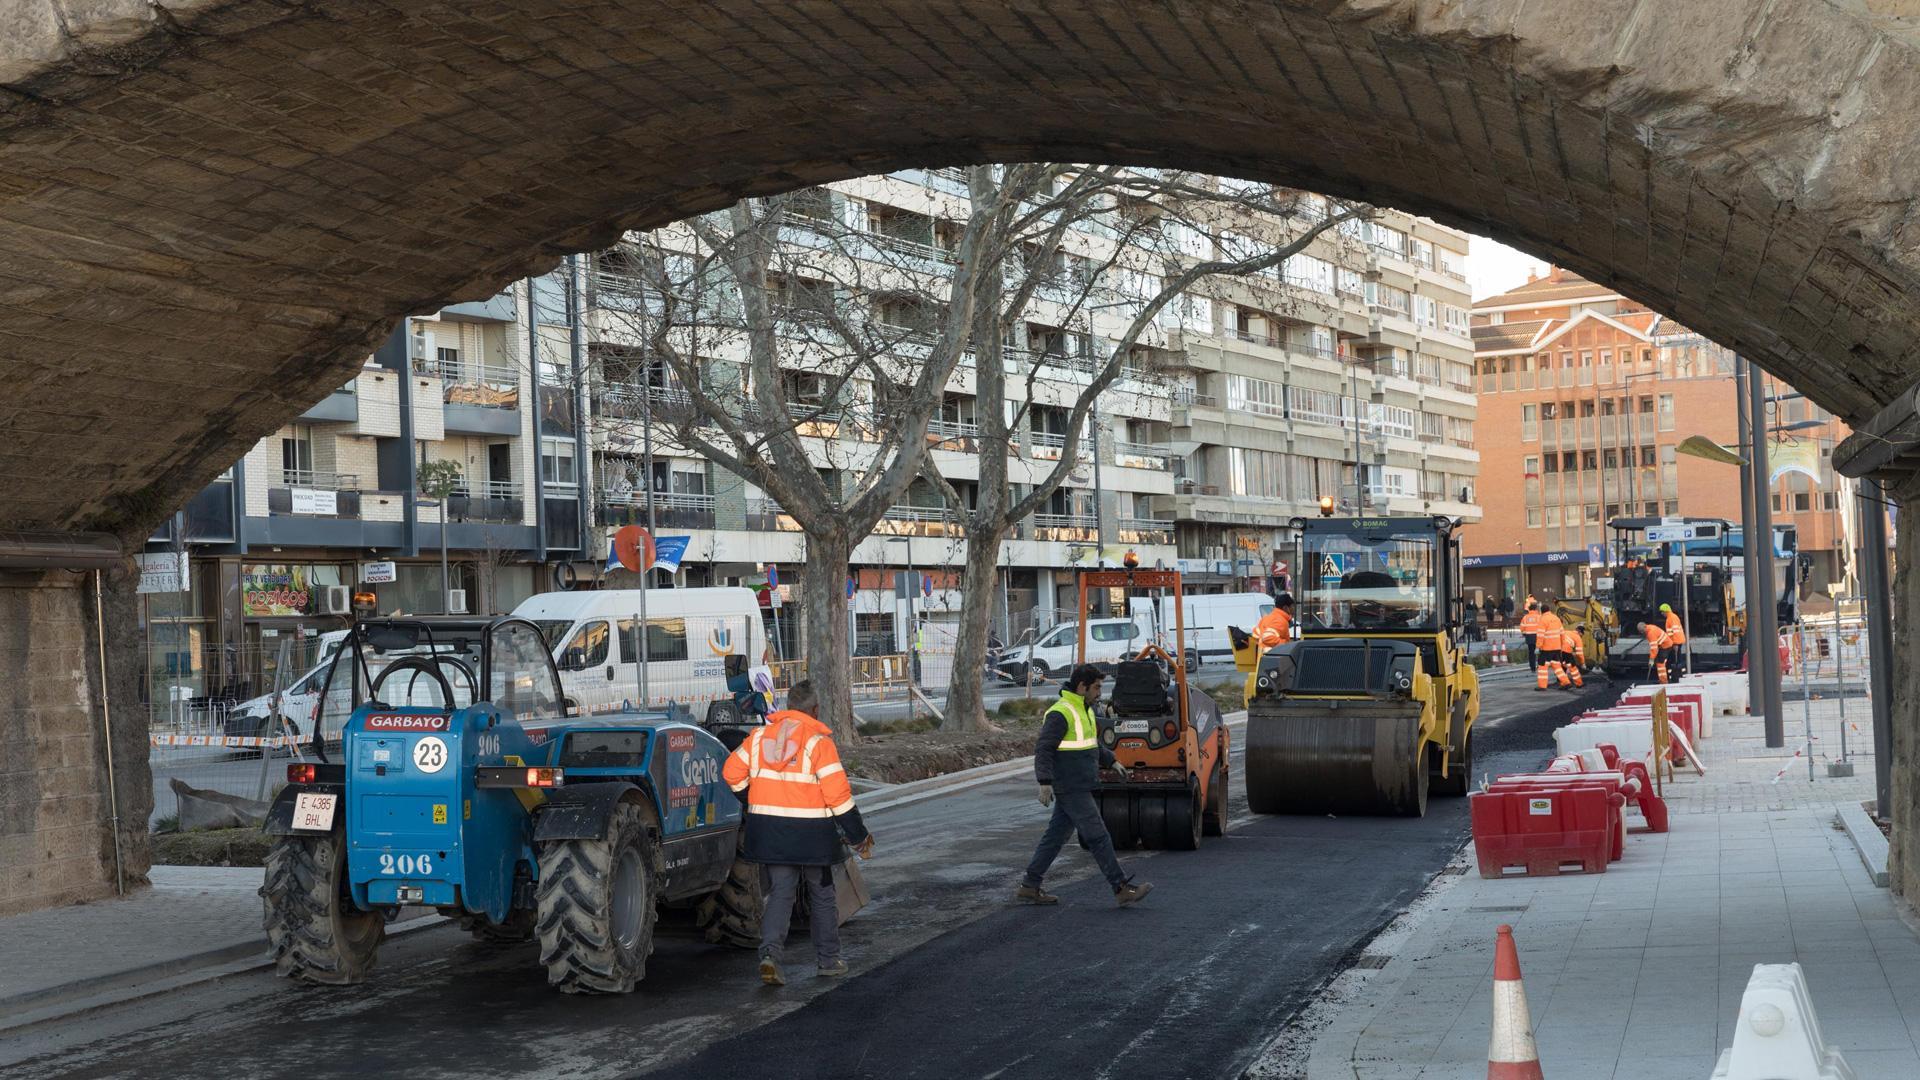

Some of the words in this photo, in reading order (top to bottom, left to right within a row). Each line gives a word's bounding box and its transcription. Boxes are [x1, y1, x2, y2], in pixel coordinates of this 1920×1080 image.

[1547, 553, 1569, 562] BBVA
[370, 716, 445, 729] GARBAYO
[478, 735, 500, 756] 206
[419, 743, 442, 766] 23
[681, 751, 719, 787] Genie
[301, 797, 307, 809] E
[311, 798, 332, 810] 4385
[305, 813, 321, 826] BHL
[380, 853, 433, 875] 206
